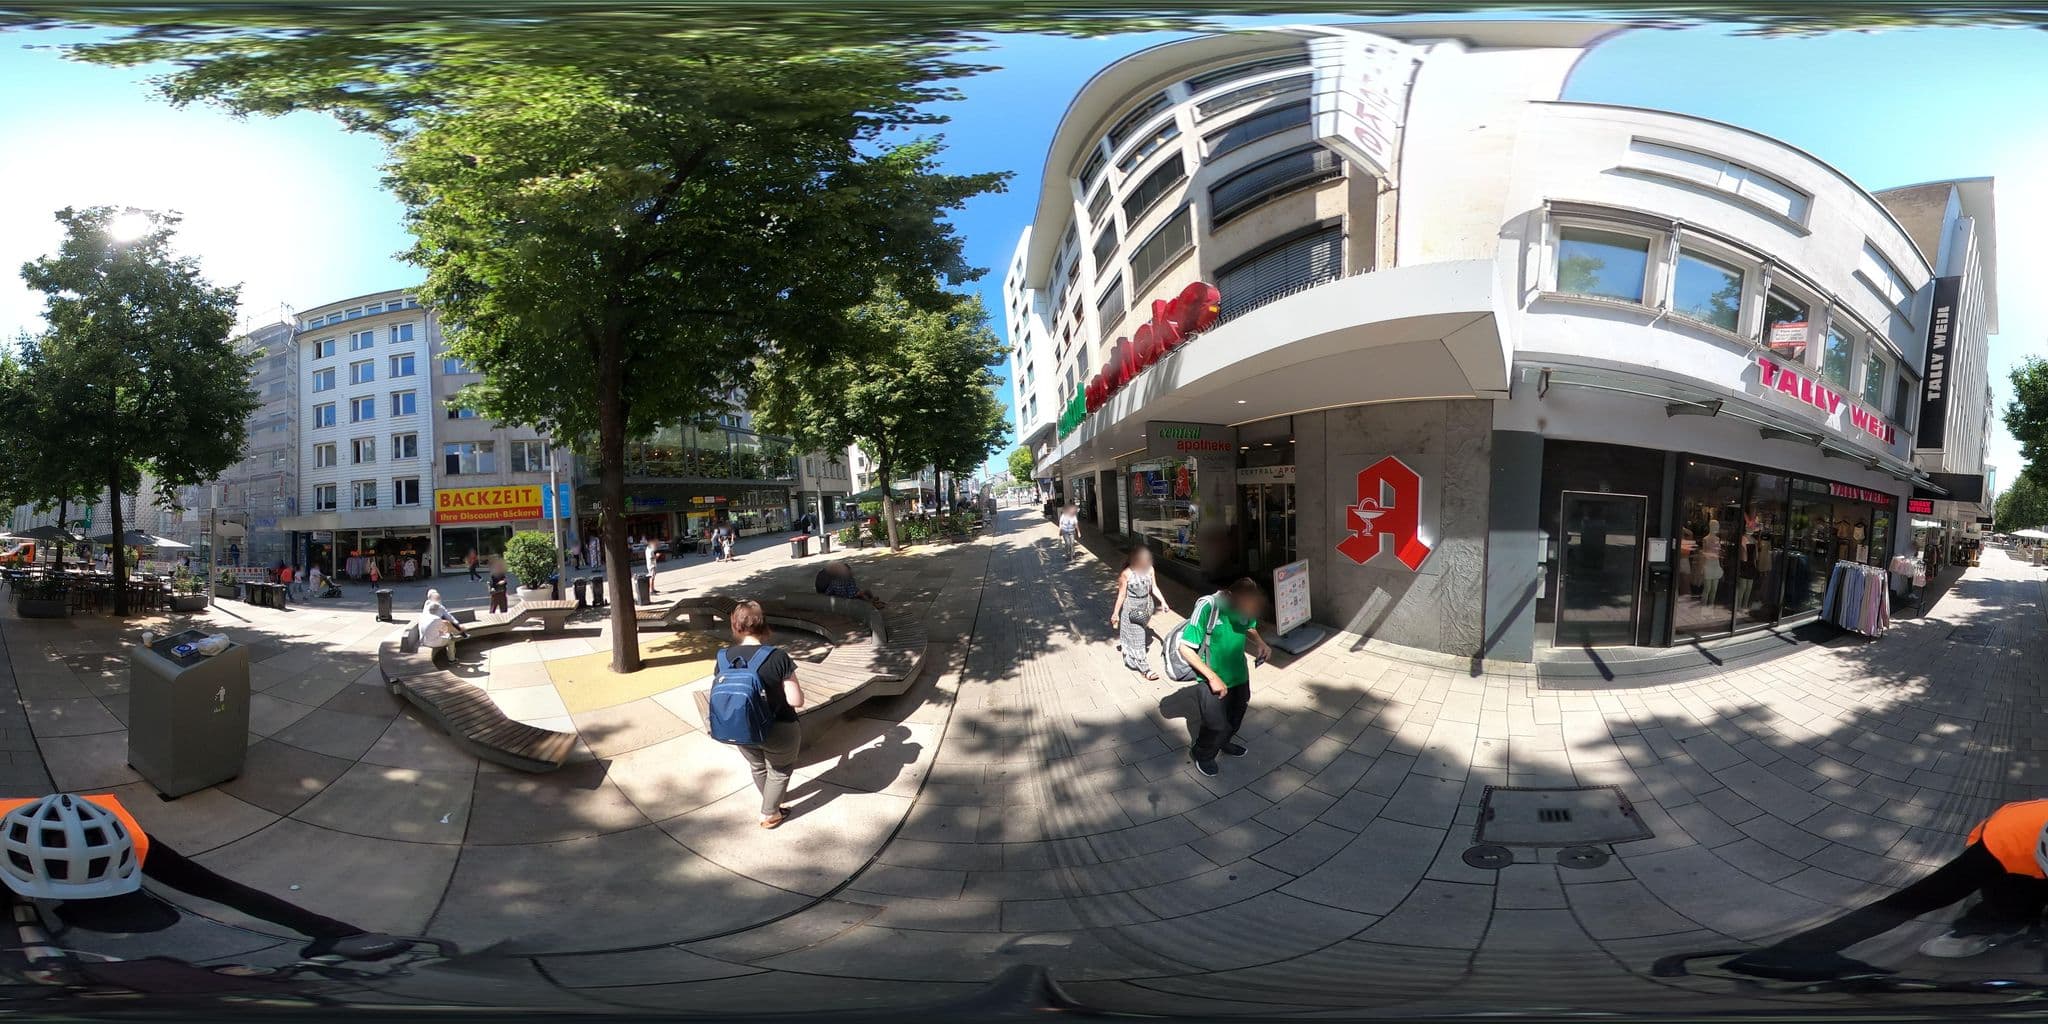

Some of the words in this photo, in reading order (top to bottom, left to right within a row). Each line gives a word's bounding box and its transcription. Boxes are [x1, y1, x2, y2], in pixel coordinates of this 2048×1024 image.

[1928, 353, 1944, 401] TALLY
[1759, 357, 1840, 414] TALLY
[1160, 424, 1200, 440] central
[1177, 441, 1232, 453] apotheke
[440, 513, 458, 521] Ihre
